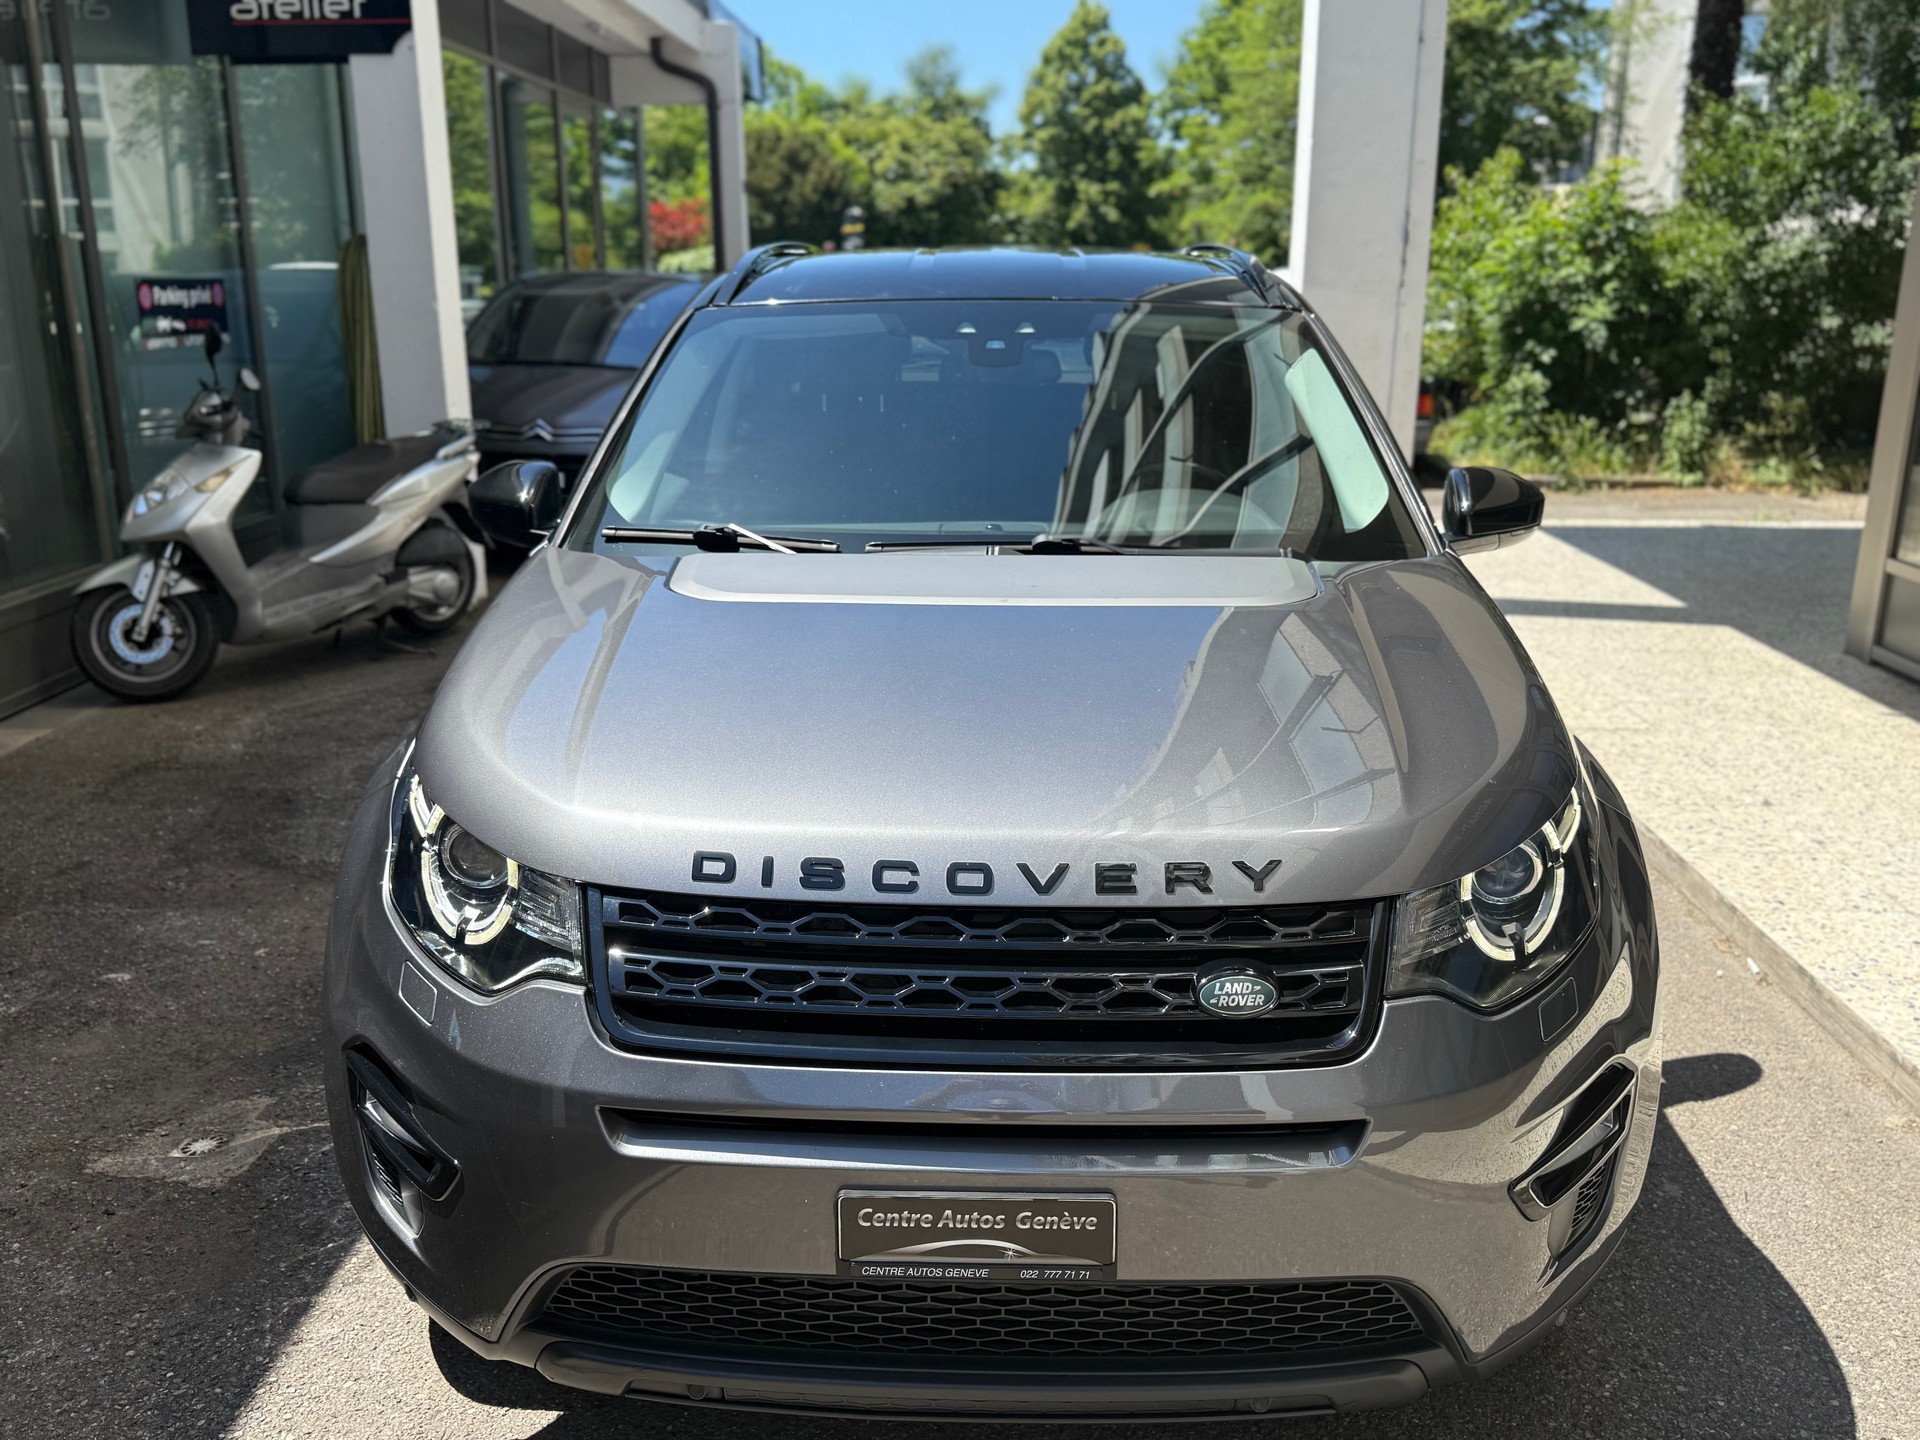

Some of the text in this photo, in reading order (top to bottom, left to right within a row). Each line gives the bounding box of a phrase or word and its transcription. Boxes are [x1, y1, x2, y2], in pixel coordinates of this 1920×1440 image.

[691, 850, 1282, 895] DISCOVERY
[1214, 982, 1252, 994] LAND
[1218, 995, 1265, 1007] ROVER
[857, 1207, 1098, 1231] Centre Autos Genève
[861, 1266, 990, 1278] CENTRE AUTOS GENEVE
[1020, 1270, 1091, 1280] 022 777 71 71
